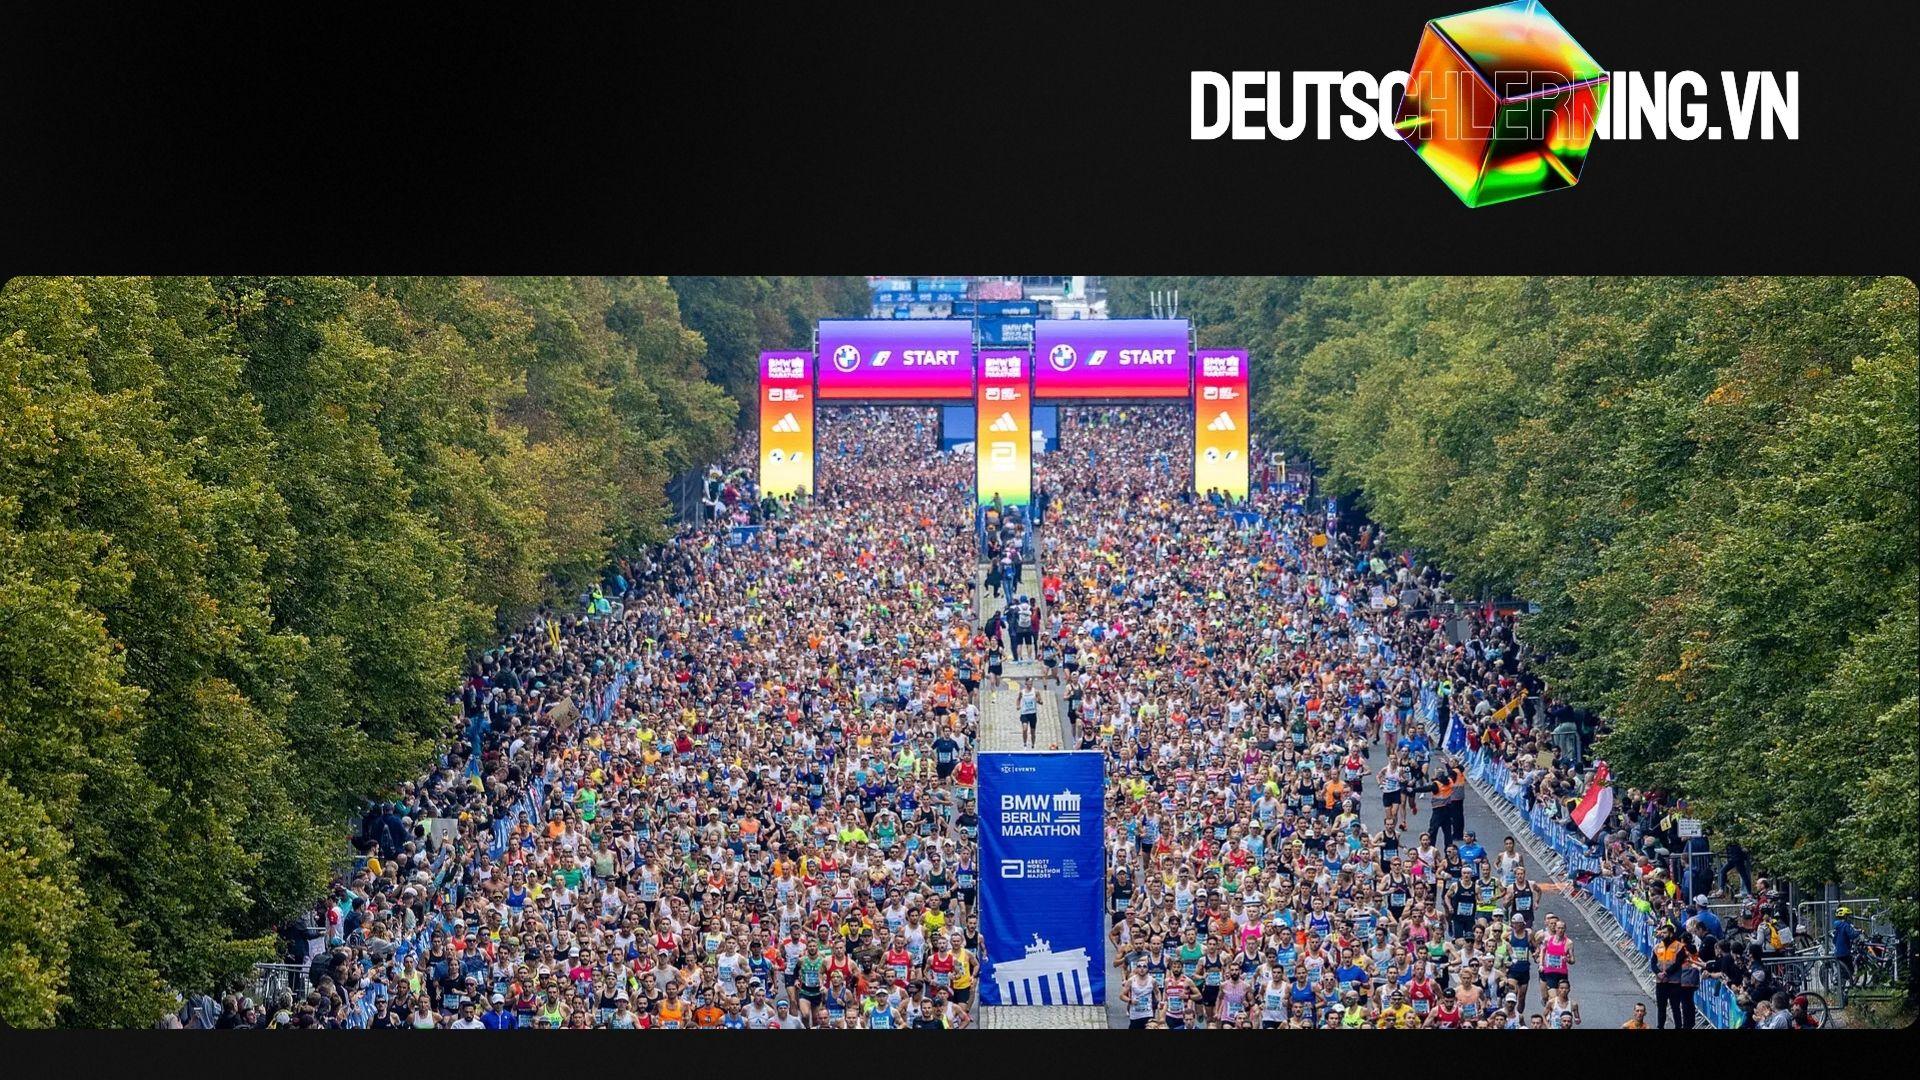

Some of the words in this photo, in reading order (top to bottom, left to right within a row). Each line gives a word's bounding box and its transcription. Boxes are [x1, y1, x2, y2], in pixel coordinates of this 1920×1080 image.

[903, 350, 960, 366] START
[1119, 349, 1176, 365] START
[1001, 794, 1050, 811] BMW
[1001, 812, 1050, 823] BERLIN
[1001, 825, 1081, 837] MARATHON
